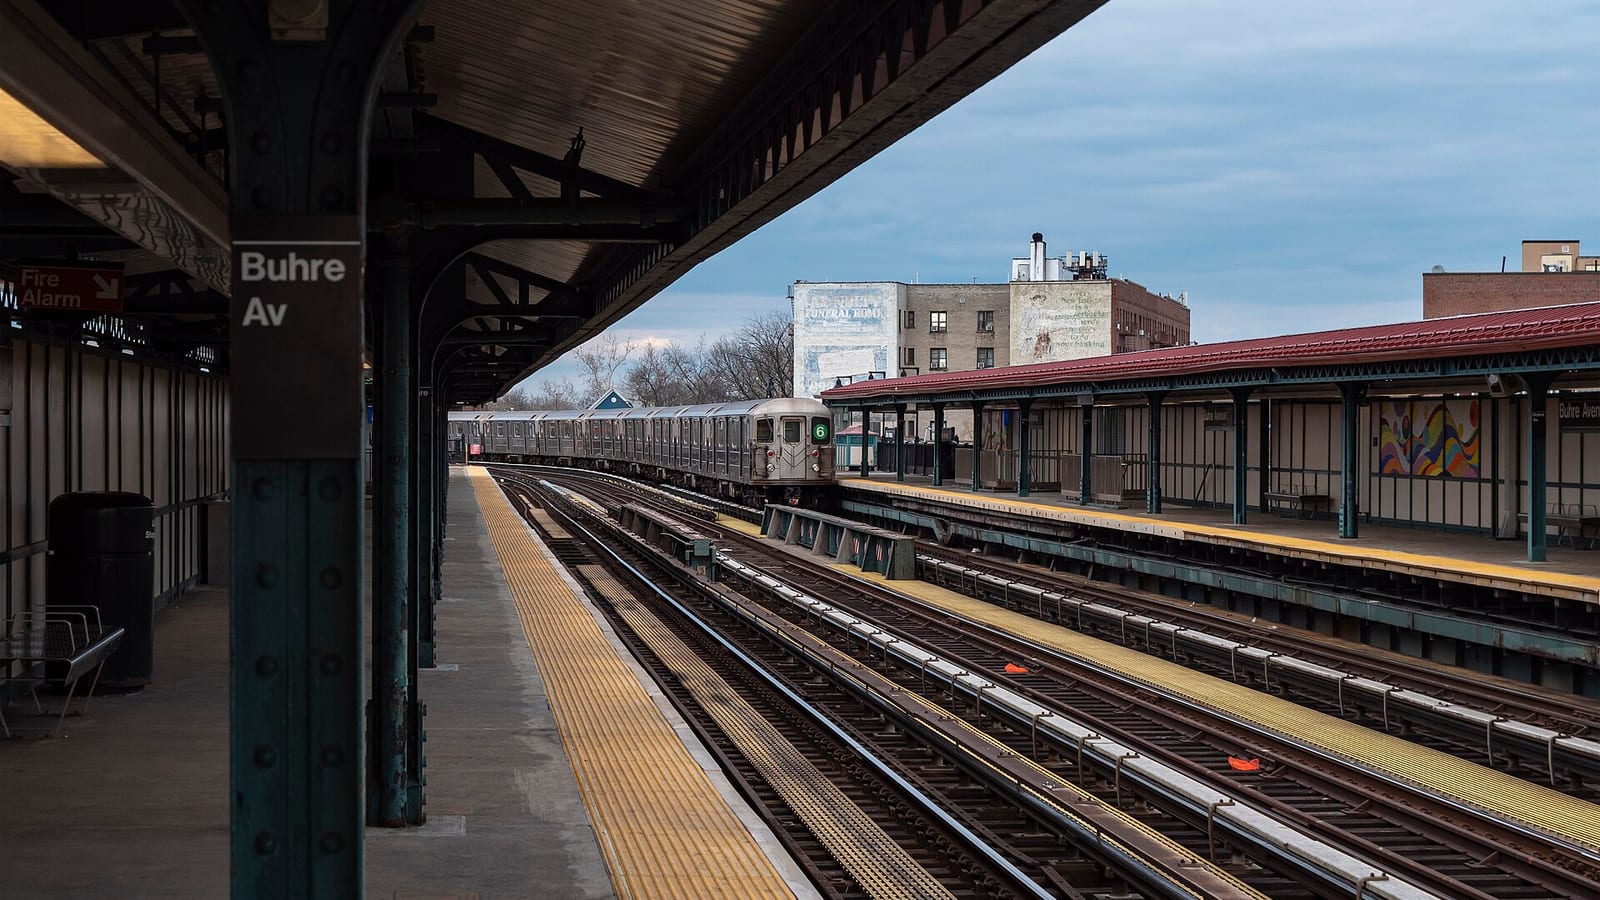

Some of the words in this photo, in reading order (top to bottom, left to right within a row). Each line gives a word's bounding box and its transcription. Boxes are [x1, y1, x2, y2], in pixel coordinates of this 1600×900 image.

[240, 252, 346, 282] Buhre
[21, 268, 60, 287] Fire
[22, 288, 81, 308] Alarm
[242, 297, 288, 327] Av
[1559, 402, 1580, 418] Buhre
[816, 426, 825, 437] 6
